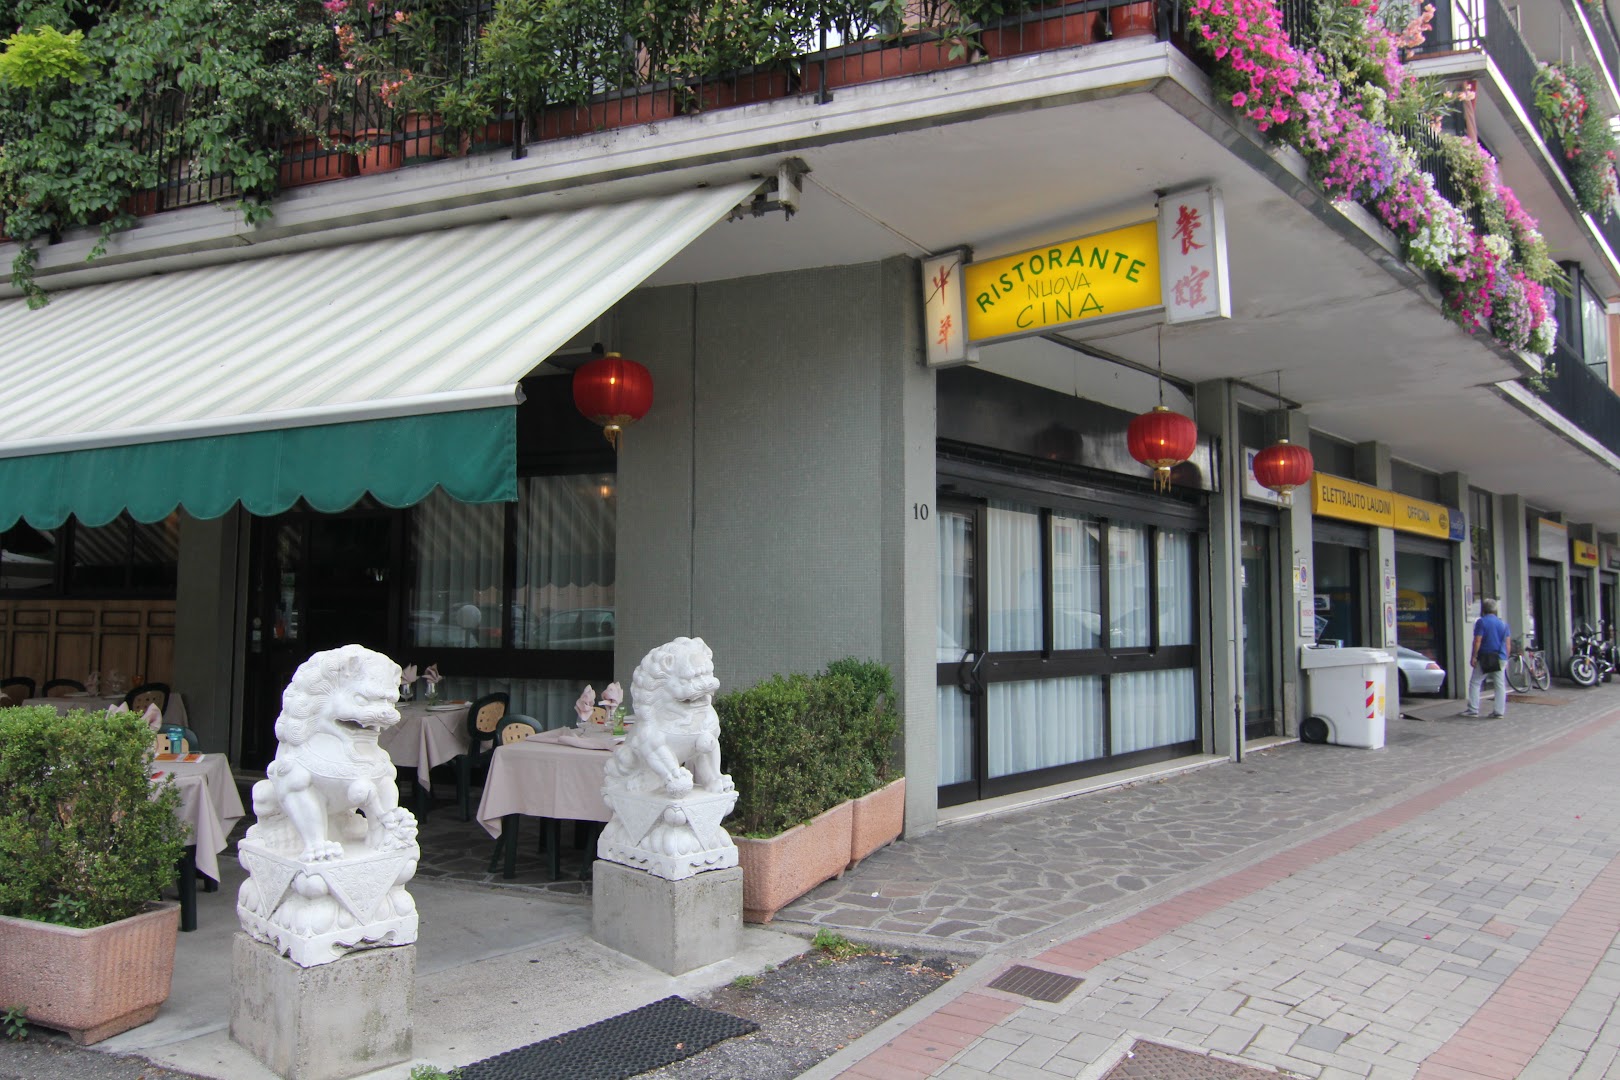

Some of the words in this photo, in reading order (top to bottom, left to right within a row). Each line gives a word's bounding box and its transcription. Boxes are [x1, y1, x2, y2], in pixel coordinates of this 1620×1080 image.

[976, 245, 1146, 313] RISTORANTE
[1027, 270, 1092, 300] NUOVA
[1016, 292, 1104, 329] CINA
[913, 502, 929, 520] 10
[1322, 485, 1366, 510] ELETTRAUTO
[1367, 497, 1391, 516] LAUDINI
[1407, 505, 1430, 522] OFFICINA
